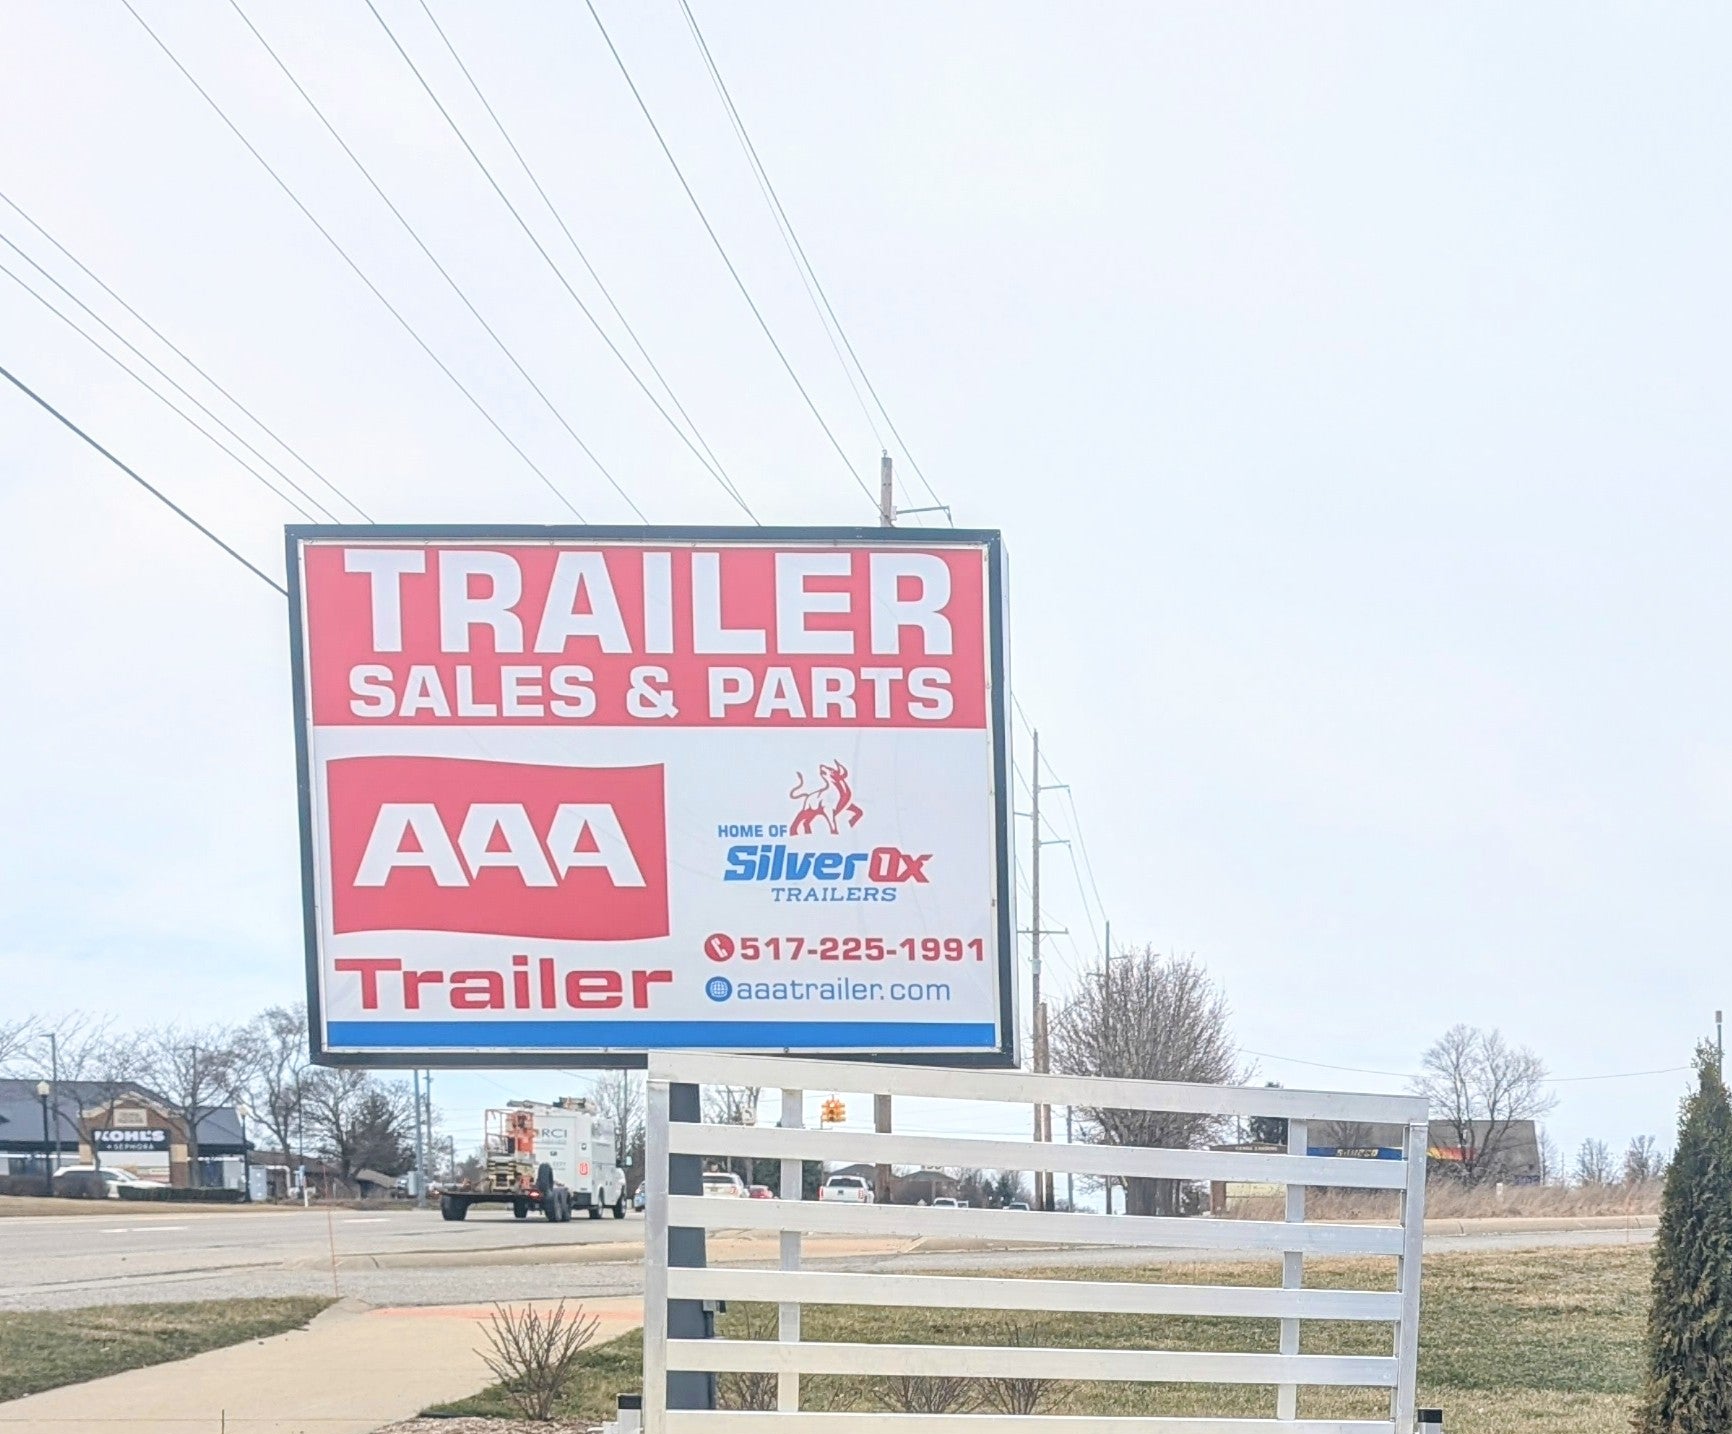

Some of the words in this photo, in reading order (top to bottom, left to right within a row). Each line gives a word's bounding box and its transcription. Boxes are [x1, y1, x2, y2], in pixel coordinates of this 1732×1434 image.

[344, 549, 953, 655] TRAILER
[348, 664, 597, 718] SALES
[626, 665, 680, 719] &
[708, 666, 954, 720] PARTS
[353, 803, 647, 887] AAA
[718, 825, 764, 838] HOME
[768, 825, 788, 838] OF
[723, 844, 933, 884] SilverOx
[771, 887, 897, 902] TRAILERS
[740, 937, 984, 961] 517-225-1991
[334, 955, 673, 1010] Trailer
[737, 977, 950, 1001] aaatrailer.com
[94, 1130, 165, 1142] KOHL'S
